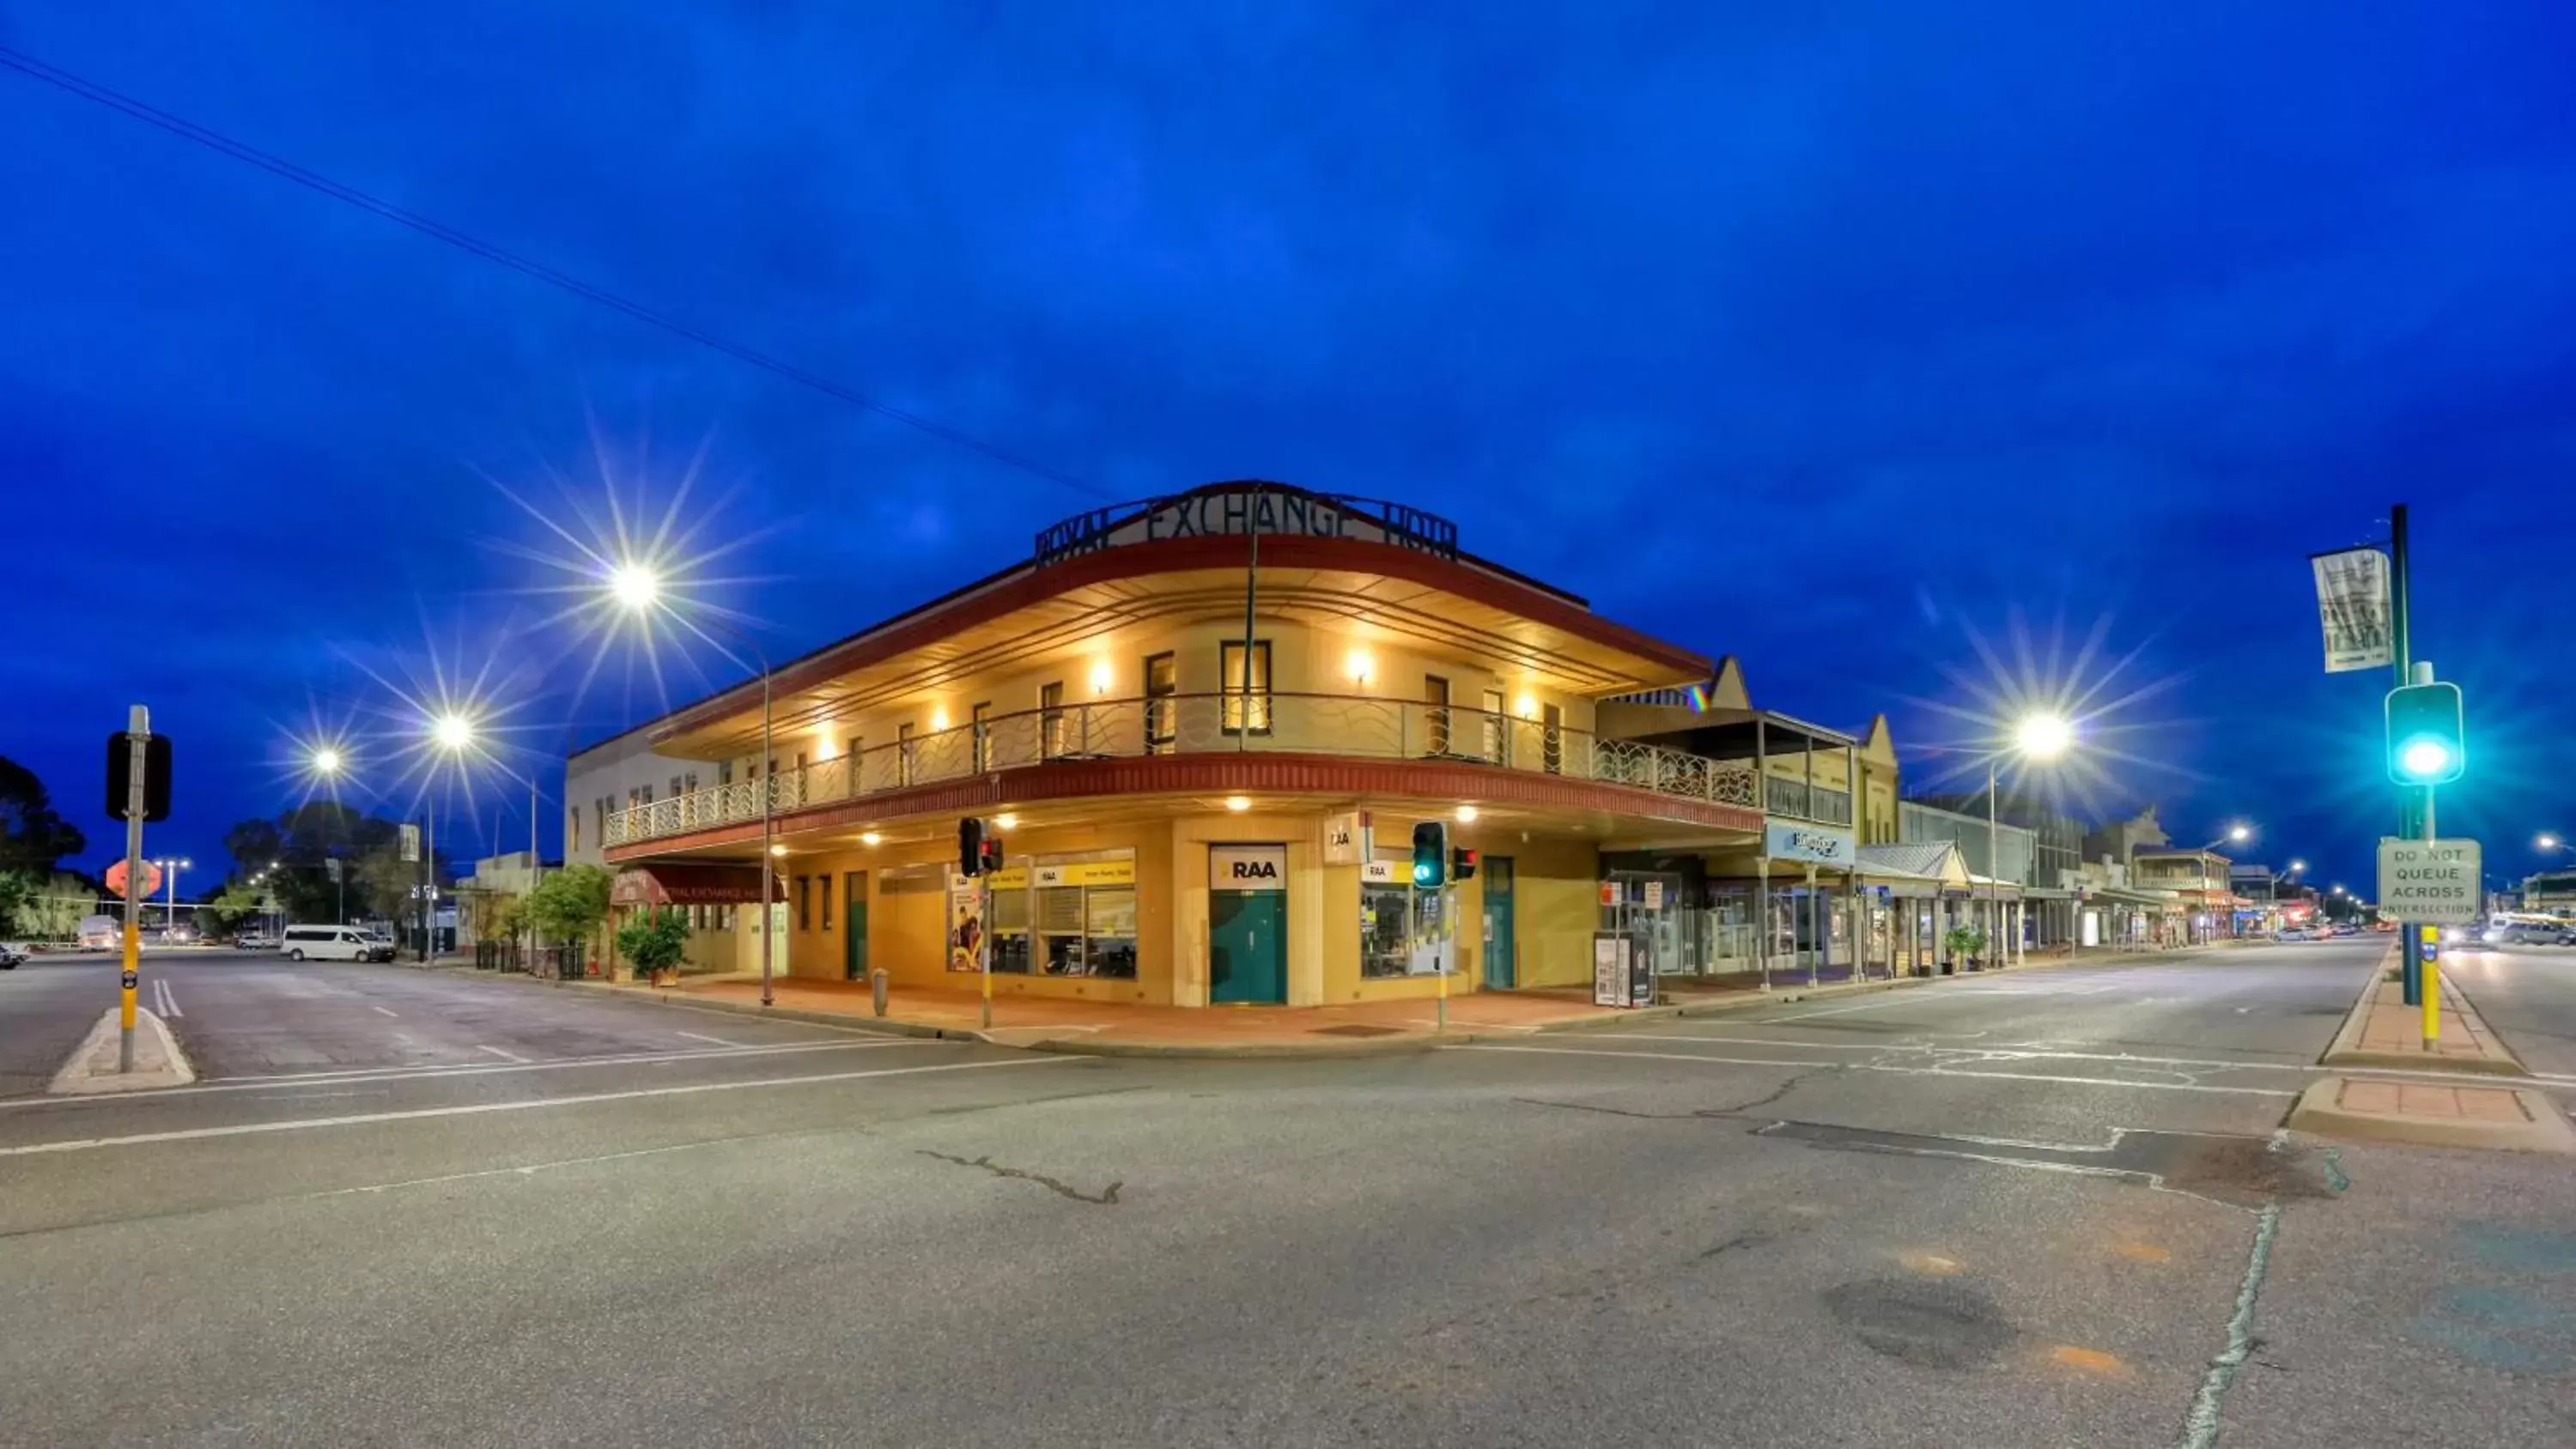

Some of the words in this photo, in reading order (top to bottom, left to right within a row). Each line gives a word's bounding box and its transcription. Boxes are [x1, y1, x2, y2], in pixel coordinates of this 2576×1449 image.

[1146, 493, 1356, 542] EXCHANGE
[2395, 851, 2417, 861] DO
[2428, 849, 2464, 861] NOT
[1233, 861, 1277, 878] RAA
[1370, 866, 1386, 876] RAA
[2397, 868, 2460, 880] QUEUE
[2392, 887, 2464, 898] ACROSS
